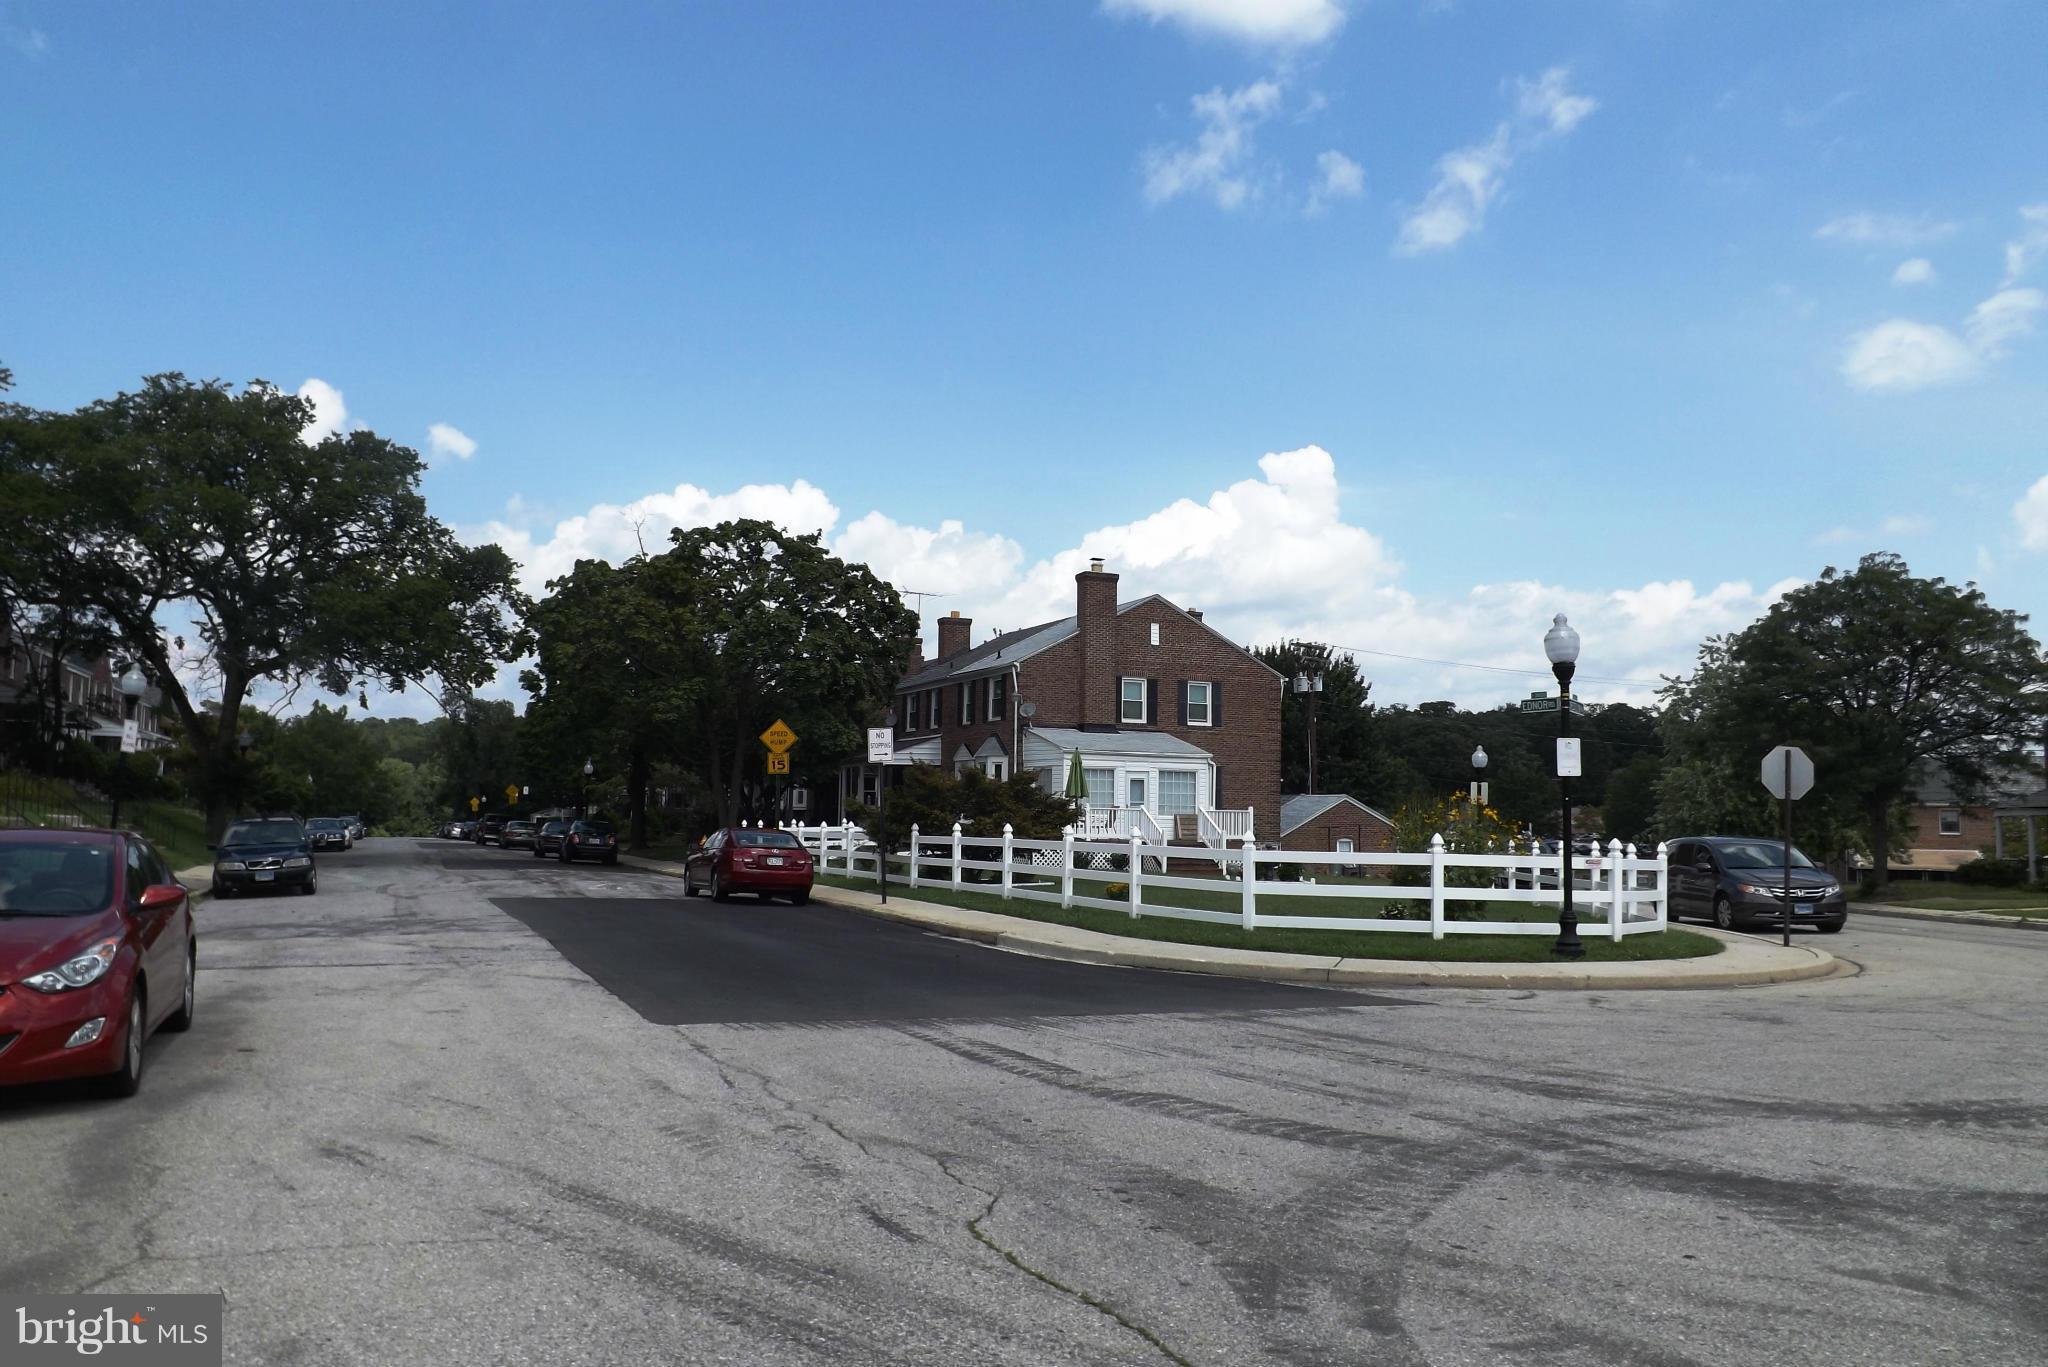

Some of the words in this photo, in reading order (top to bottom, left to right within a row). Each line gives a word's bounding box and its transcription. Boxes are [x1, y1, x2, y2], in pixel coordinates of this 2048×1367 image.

[1522, 701, 1548, 711] EDNOR
[875, 731, 885, 739] NO
[771, 760, 786, 770] 15
